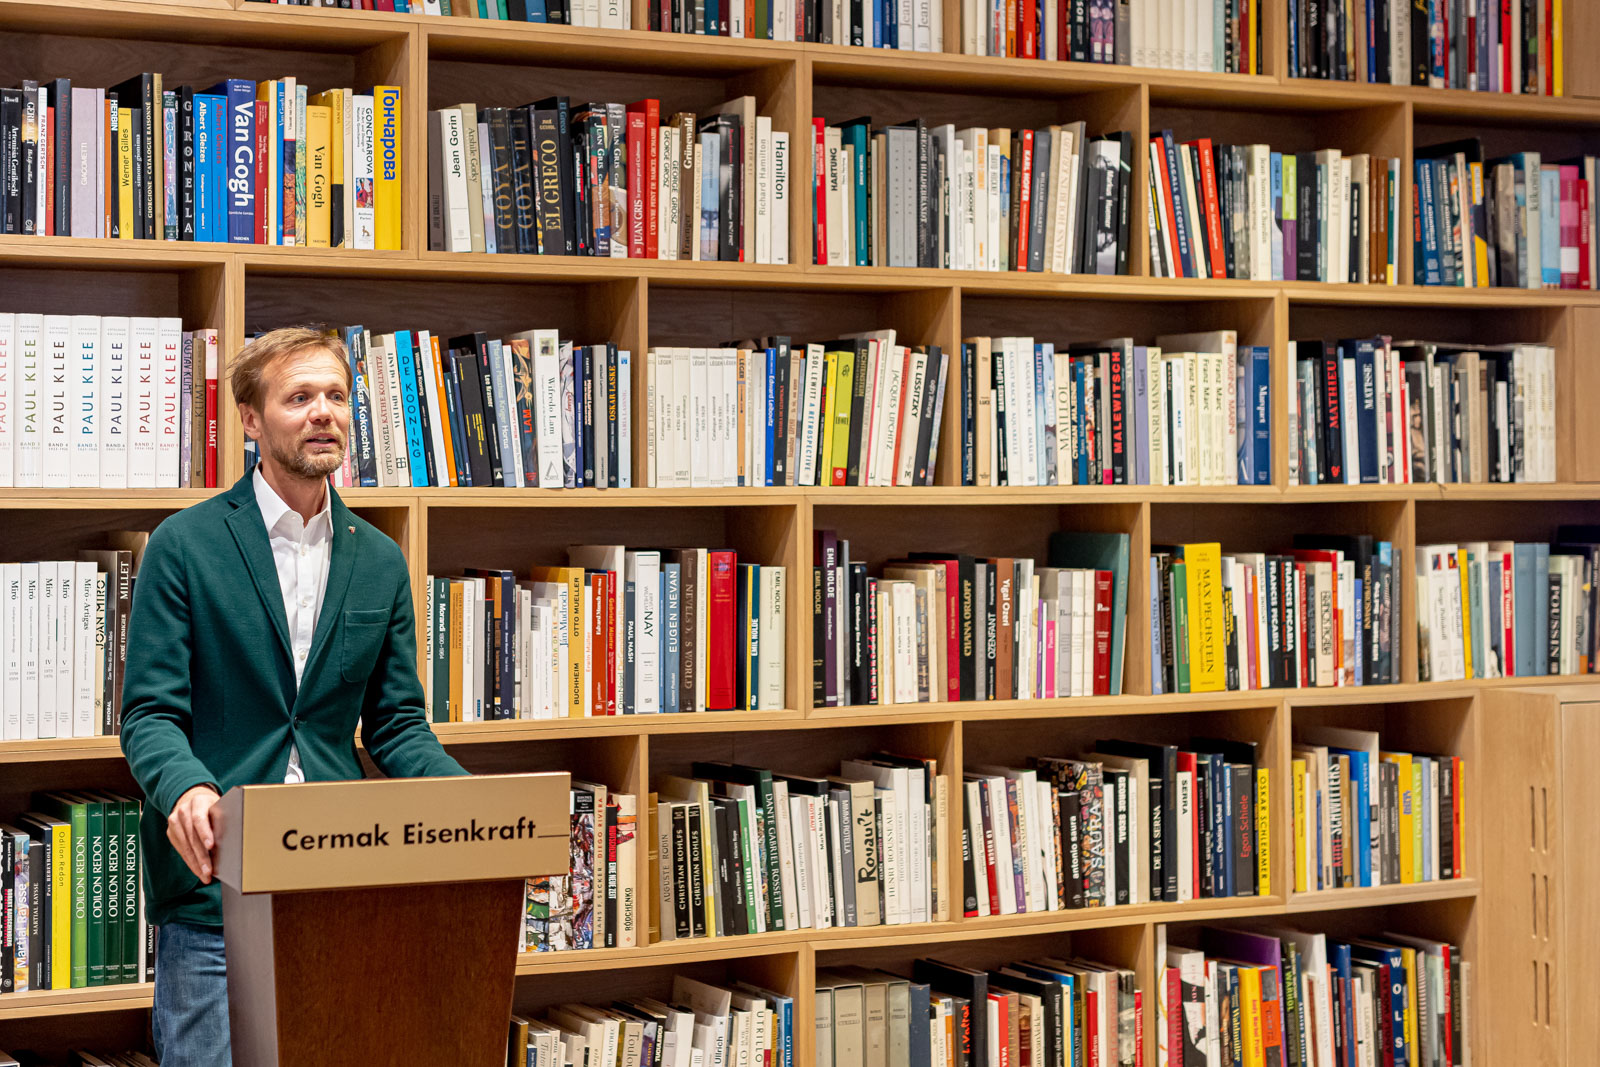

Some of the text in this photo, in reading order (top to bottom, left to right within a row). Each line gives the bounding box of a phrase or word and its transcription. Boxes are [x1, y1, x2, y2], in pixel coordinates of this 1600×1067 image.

[229, 101, 254, 207] Van Gogh
[380, 89, 399, 181] Гончарова
[449, 115, 461, 177] Jean Gorin
[683, 117, 693, 169] Grünewald
[312, 146, 326, 209] Van Gogh
[541, 139, 561, 232] EL GRECO
[775, 141, 786, 200] Hamilton
[1168, 149, 1187, 254] CHAGALL DISCOVERED
[25, 339, 36, 433] PAUL KLEE
[53, 341, 65, 433] PAUL KLEE
[82, 342, 94, 434] PAUL KLEE
[111, 343, 122, 434] PAUL KLEE
[140, 342, 151, 433] PAUL KLEE
[164, 343, 176, 434] PAUL KLEE
[184, 370, 192, 396] KLIMT
[195, 384, 204, 418] KLIMT
[375, 356, 387, 396] KOLLWITZ
[401, 356, 421, 458] DE KOONING
[485, 385, 493, 408] Krasner
[547, 377, 556, 412] Wifredo
[810, 372, 818, 399] LEWITT
[911, 360, 924, 418] EL LISSITZKY
[1111, 352, 1123, 454] MALEWITSCH
[1327, 360, 1339, 429] MATHIEU
[1363, 363, 1374, 410] MATISSE
[208, 420, 217, 448] KLIMT
[356, 375, 370, 460] Oskar Kokoschka
[378, 397, 388, 424] KÄTHE
[523, 409, 532, 433] LAM
[805, 410, 816, 471] RETROSPECTIVE
[1058, 386, 1070, 451] MAILLOL
[1152, 415, 1160, 452] HENRI
[120, 561, 129, 600] MILLET
[826, 548, 835, 598] EMIL NOLDE
[669, 571, 678, 653] EUGEN NEVAN
[987, 612, 996, 660] OZENFANT
[1204, 601, 1214, 673] PECHSTEIN
[1550, 585, 1560, 658] POUSSIN
[1118, 776, 1126, 812] GEORGE
[282, 816, 536, 851] Cermak Eisenkraft
[766, 793, 782, 908] DANTE GABRIEL ROSSETTI
[1089, 803, 1104, 869] SAURA
[1153, 805, 1161, 870] DE LA SERNA
[1240, 795, 1252, 858] Egon Schiele
[76, 836, 85, 919] ODILON REDON
[92, 836, 102, 918] ODILON REDON
[108, 835, 118, 917] ODILON REDON
[126, 834, 136, 917] ODILON REDON
[1071, 844, 1079, 879] antonio
[16, 883, 27, 969] Martial Raysse
[715, 1036, 723, 1064] Ullrich
[755, 1011, 764, 1063] UTRILLO
